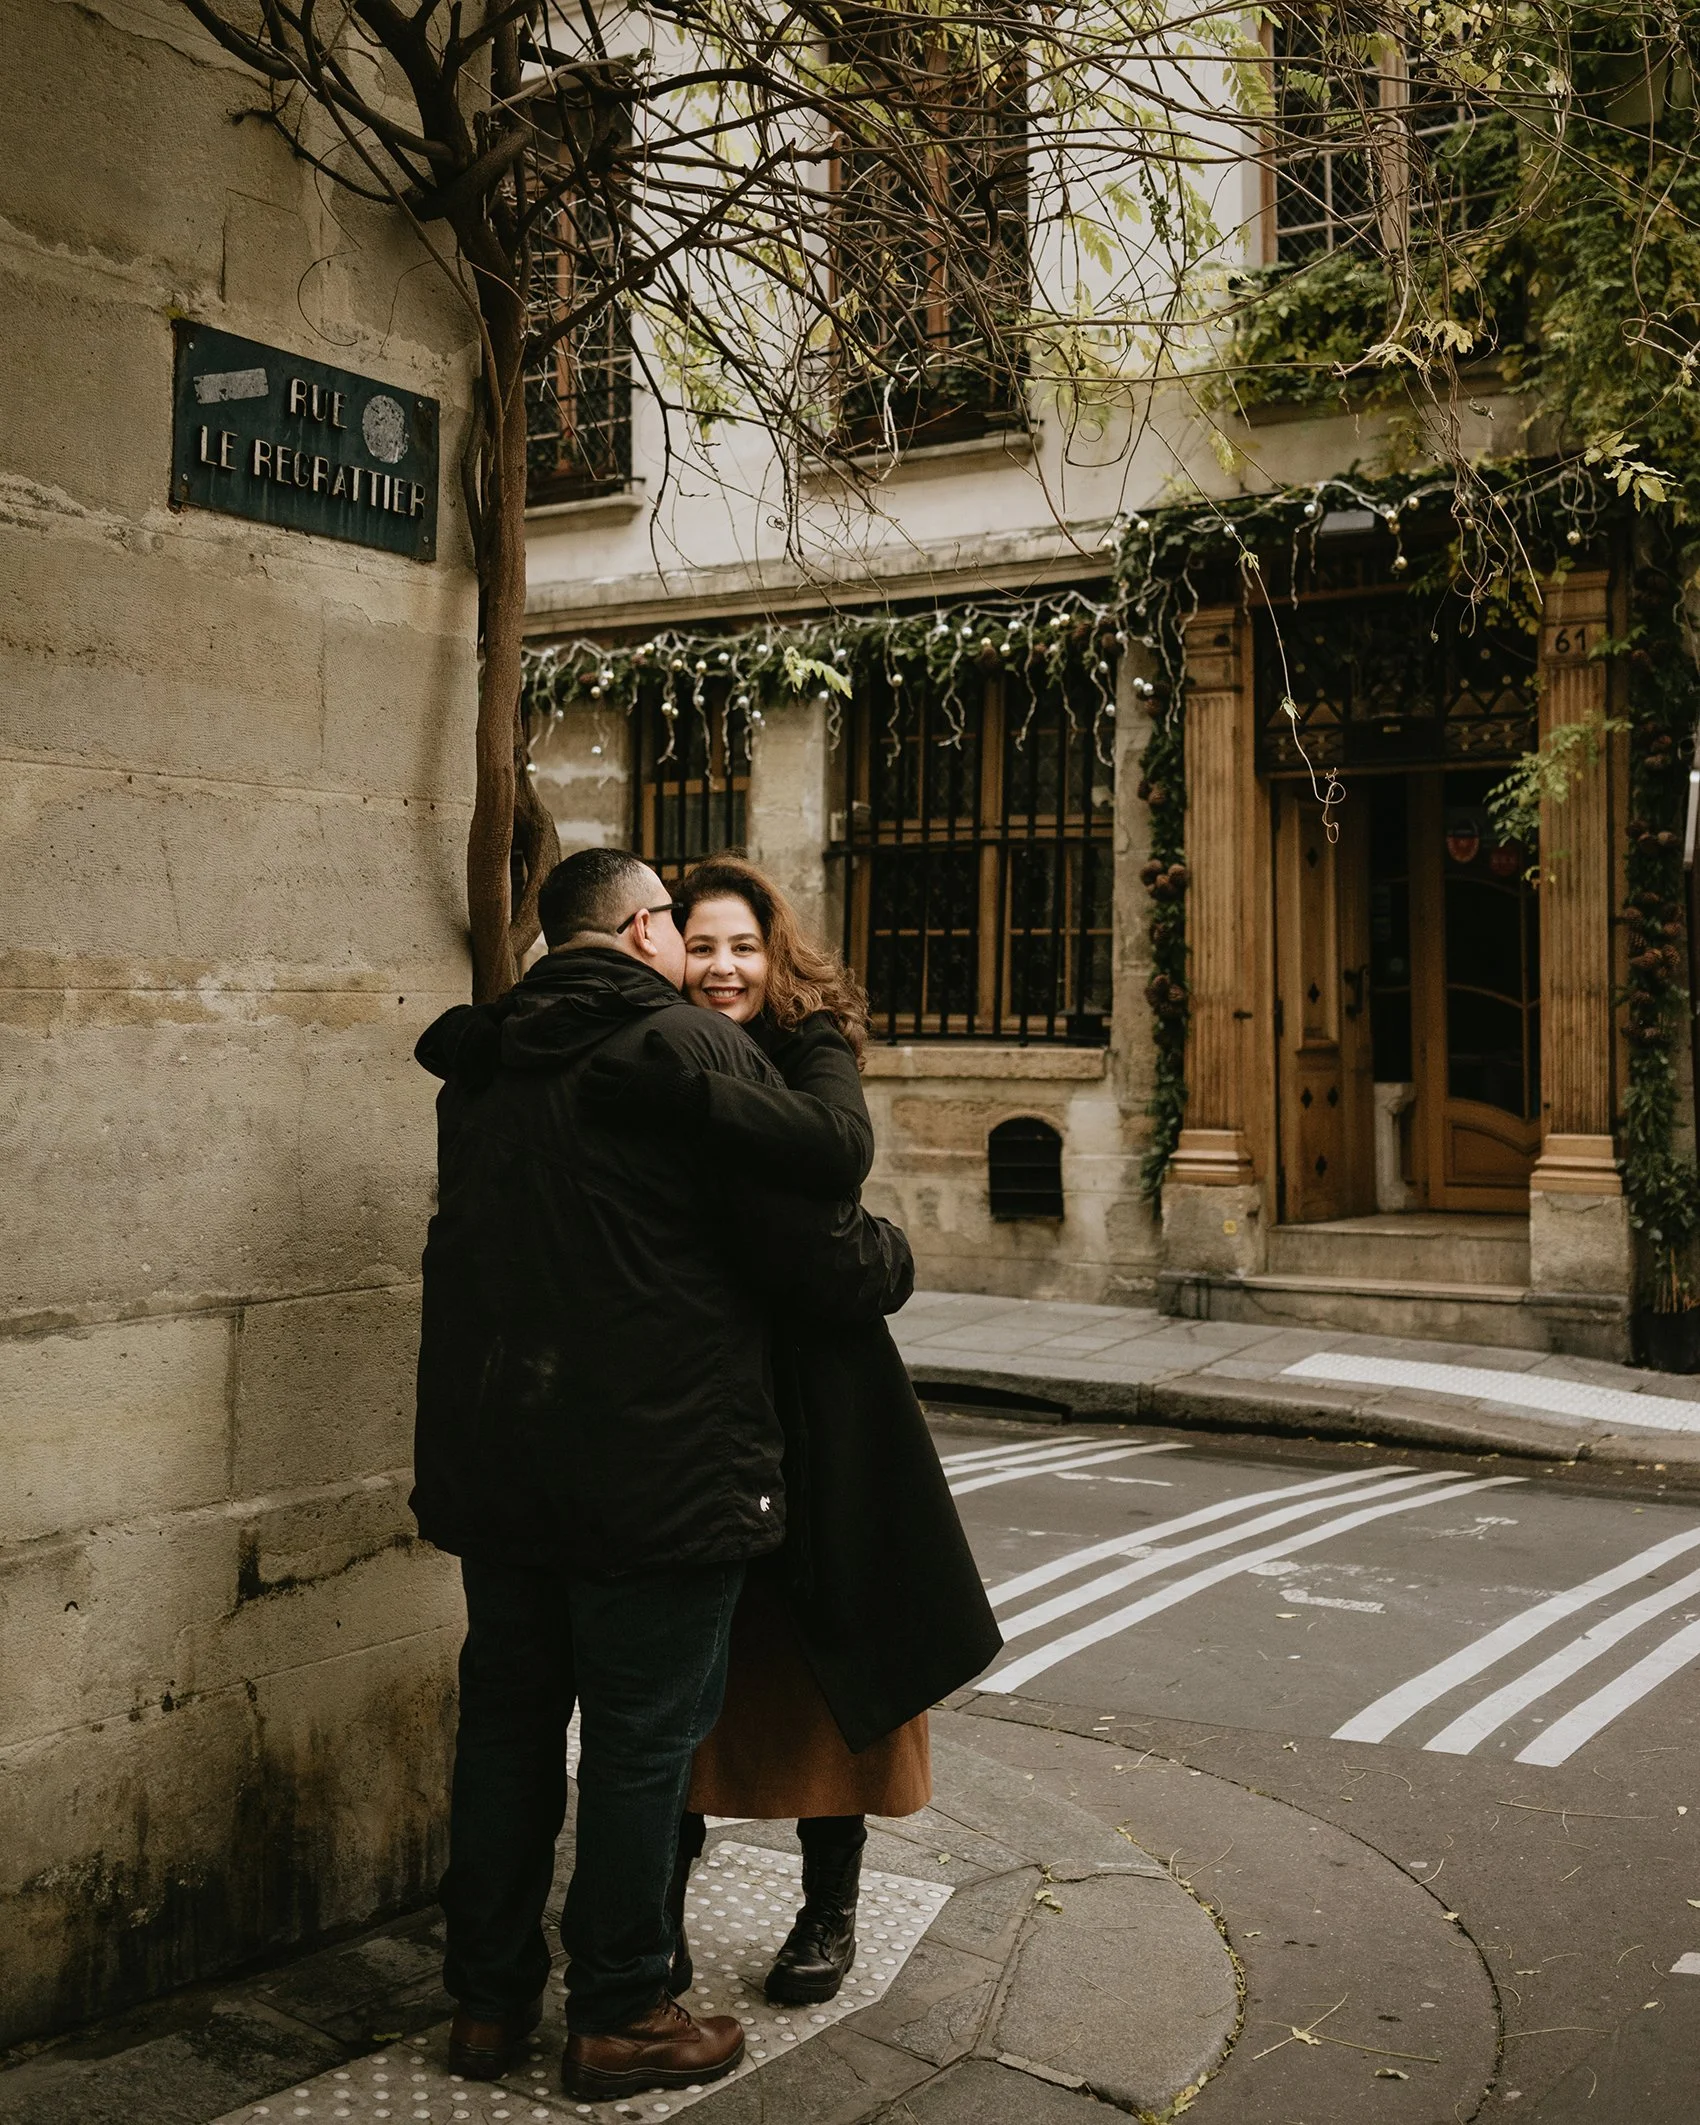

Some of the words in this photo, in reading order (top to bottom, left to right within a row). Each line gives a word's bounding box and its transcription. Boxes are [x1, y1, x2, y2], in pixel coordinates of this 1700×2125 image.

[290, 377, 348, 430] RUE
[200, 424, 239, 471] LE
[253, 438, 426, 517] REGRATTIER
[1554, 627, 1587, 654] 61
